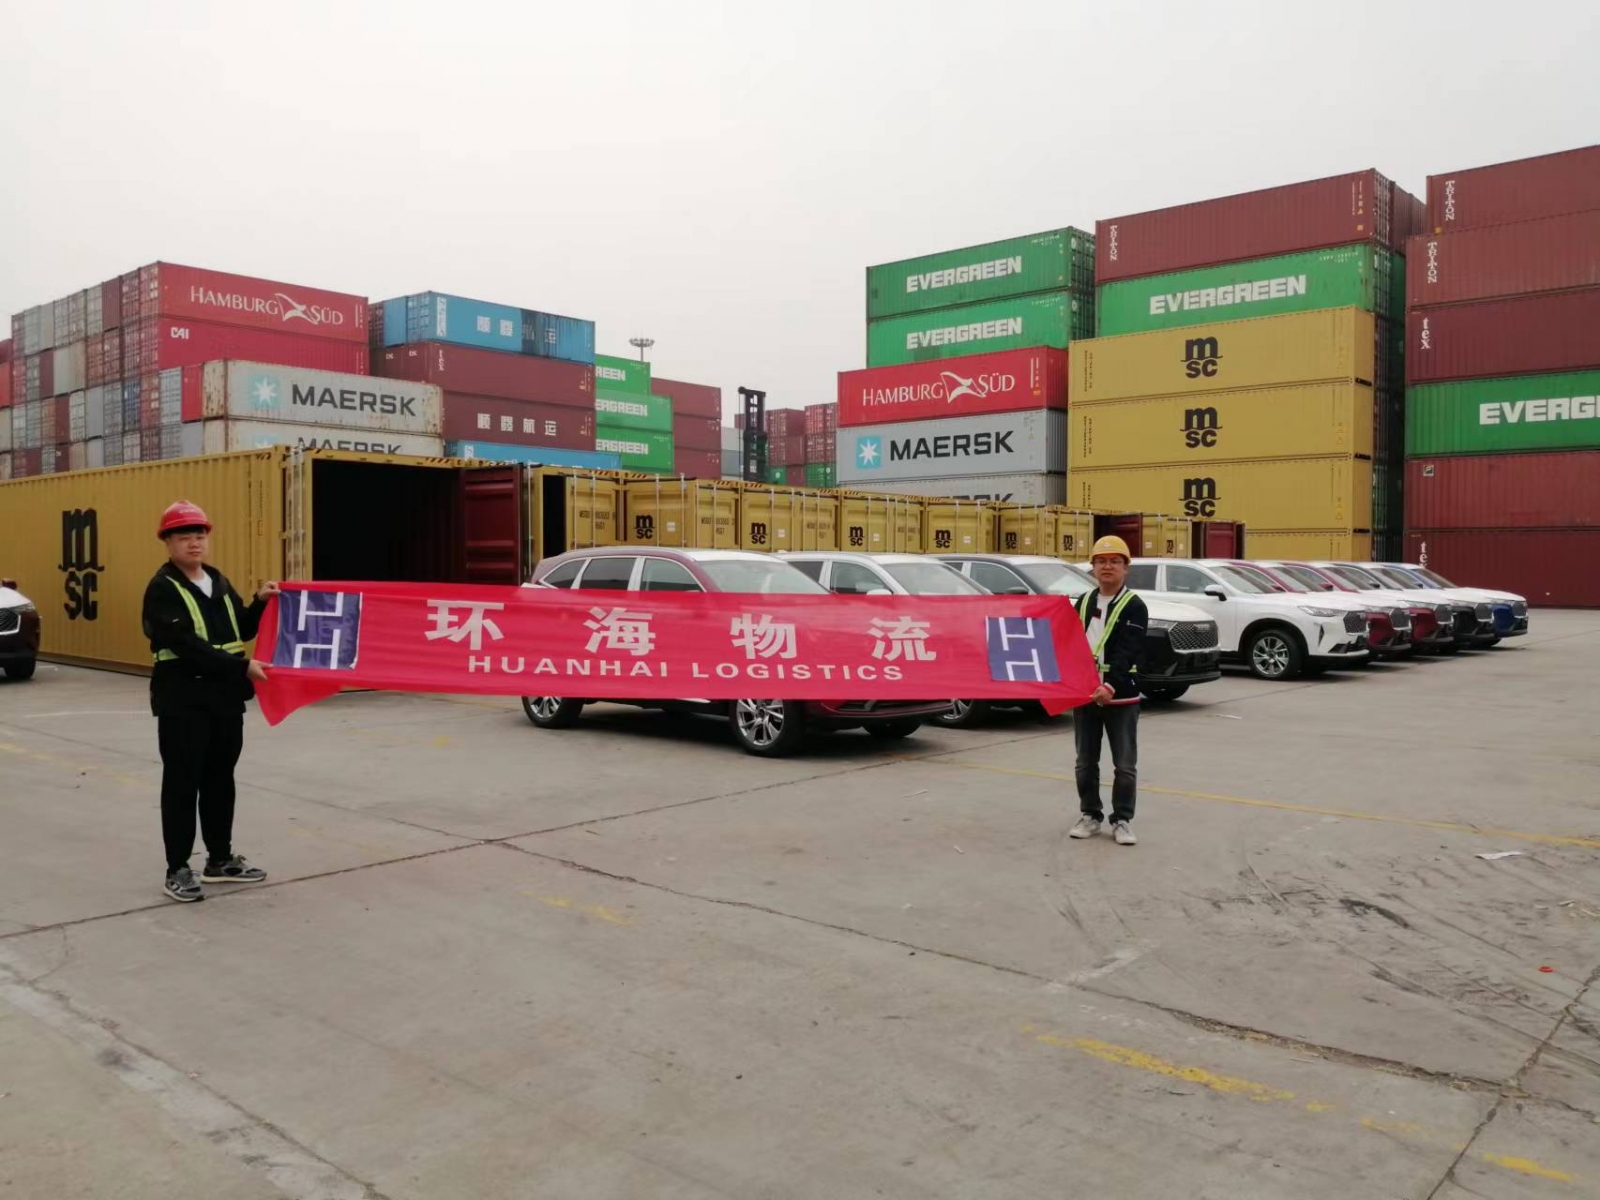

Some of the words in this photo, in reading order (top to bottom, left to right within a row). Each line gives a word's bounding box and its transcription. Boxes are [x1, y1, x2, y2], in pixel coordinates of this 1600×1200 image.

[1445, 180, 1455, 221] TRITON
[1109, 225, 1118, 261] TRITON
[907, 256, 1022, 293] EVERGREEN
[1427, 242, 1437, 283] TRITON
[190, 285, 278, 315] HAMBURG
[311, 304, 343, 325] SÜD
[1150, 275, 1306, 315] EVERGREEN
[171, 326, 189, 340] CAI
[906, 317, 1022, 350] EVERGREEN
[1420, 317, 1431, 350] tex
[292, 384, 416, 417] MAERSK
[862, 382, 943, 406] HAMBURG
[978, 373, 1015, 392] SÜD
[1479, 395, 1600, 425] EVERG
[890, 430, 1014, 461] MAERSK
[425, 599, 937, 661] 环海物流
[468, 655, 668, 678] HUANHAI
[692, 662, 904, 681] LOGISTICS
